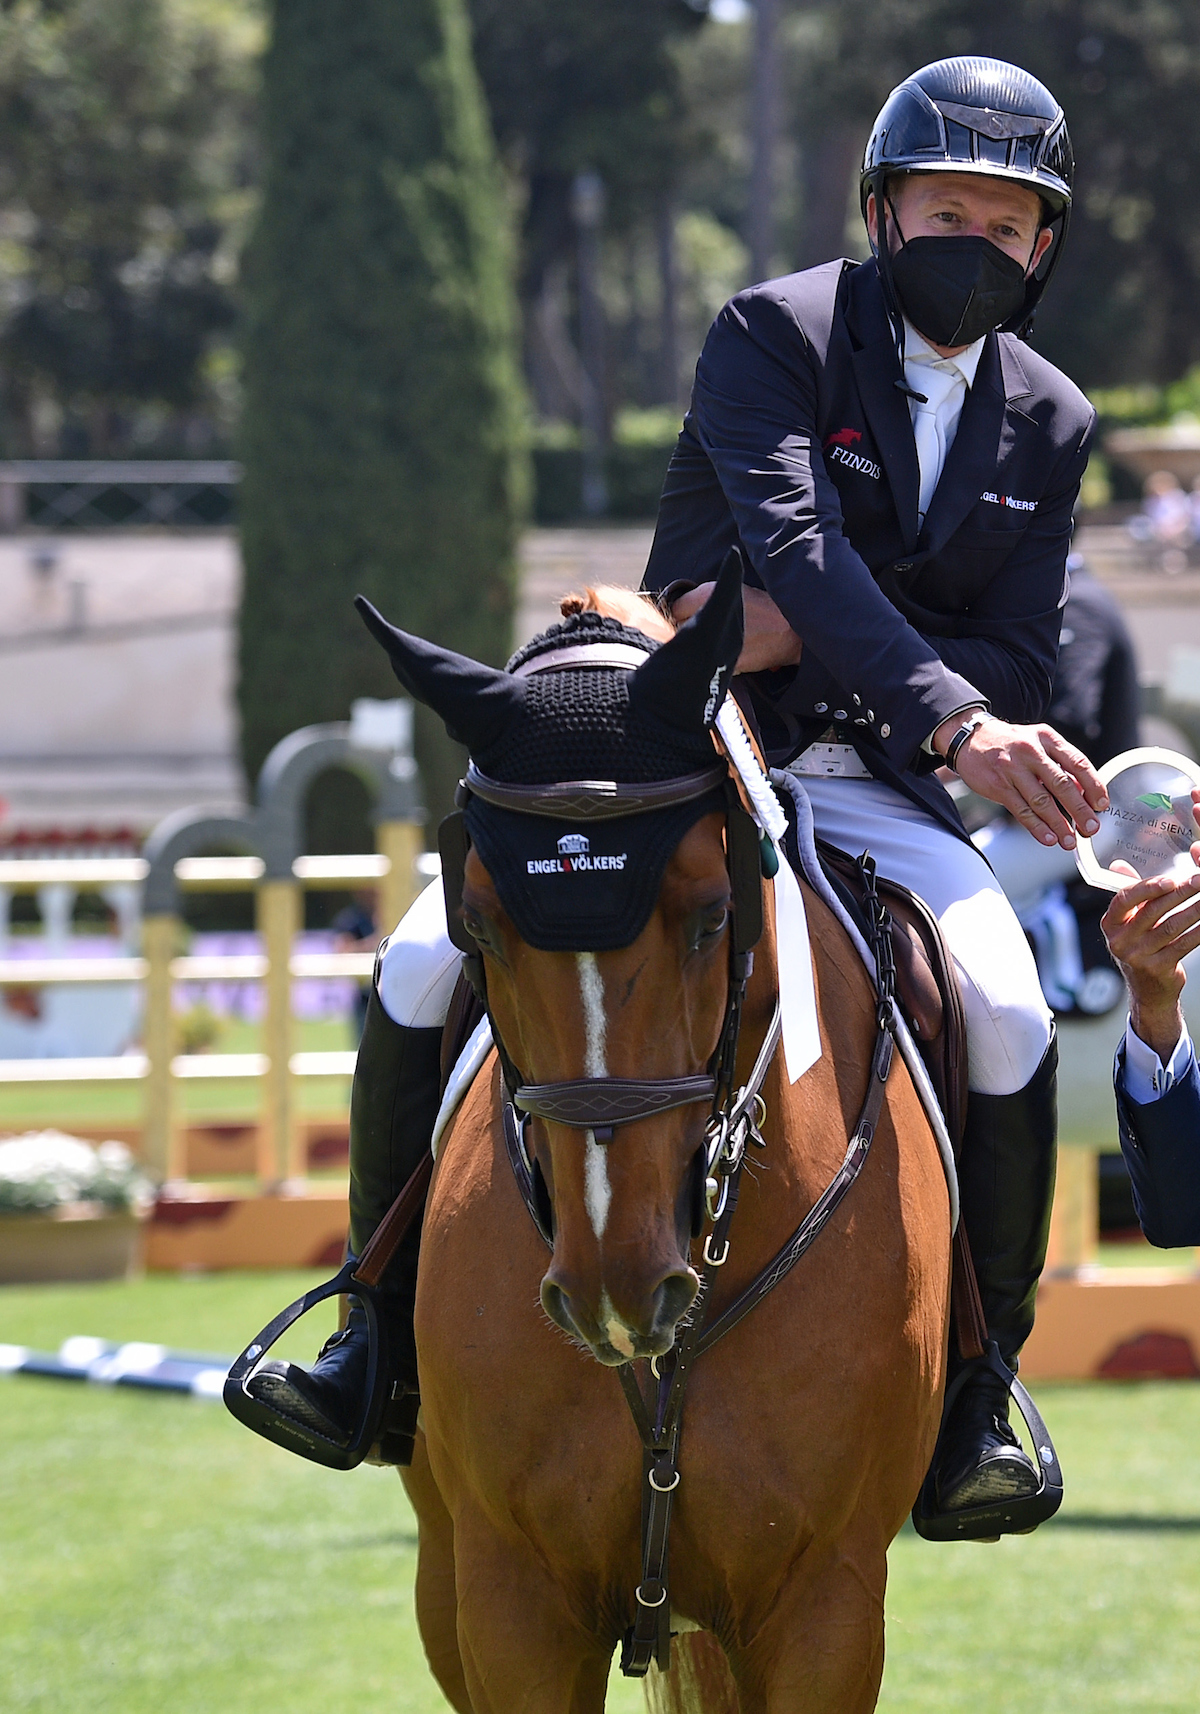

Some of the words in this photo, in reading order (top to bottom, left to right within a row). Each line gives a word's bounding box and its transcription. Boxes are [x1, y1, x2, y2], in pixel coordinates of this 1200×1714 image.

[829, 446, 882, 480] FUNDIS
[1102, 807, 1144, 824] PIAZZA
[1147, 819, 1159, 828] di
[1160, 821, 1193, 838] SIENA
[1125, 842, 1168, 860] Classificato
